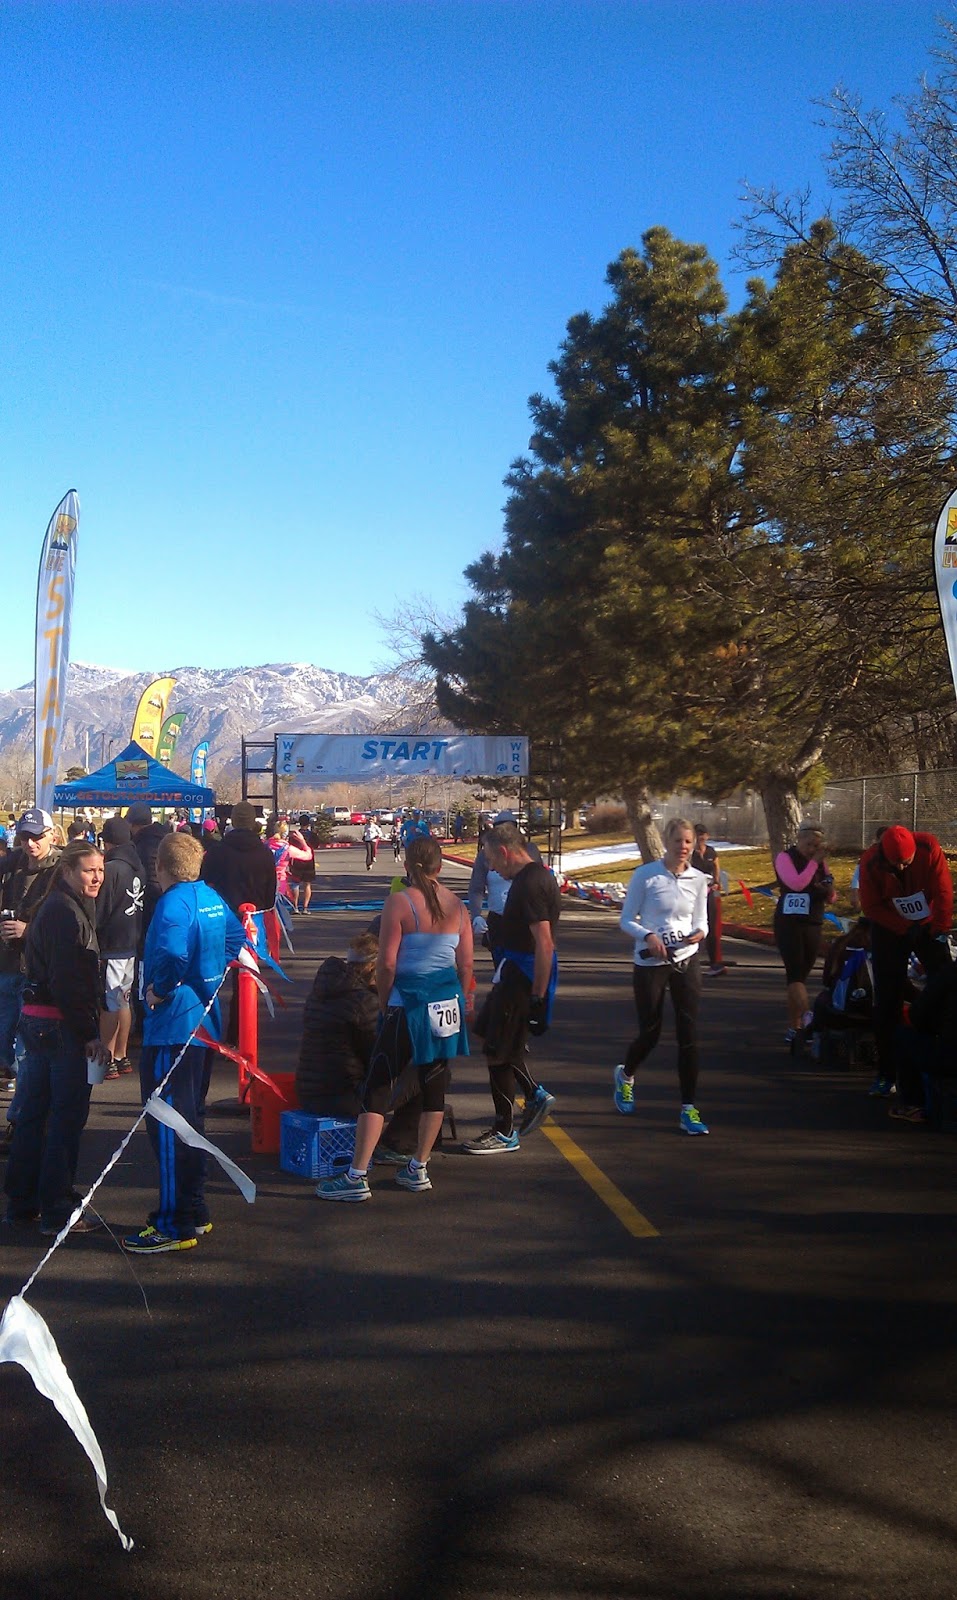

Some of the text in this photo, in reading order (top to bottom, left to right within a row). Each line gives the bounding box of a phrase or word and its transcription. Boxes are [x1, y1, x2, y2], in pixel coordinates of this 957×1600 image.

[41, 576, 65, 785] STAR
[361, 740, 447, 760] START
[789, 898, 805, 908] 602
[900, 900, 923, 914] 600
[662, 930, 684, 946] 669
[437, 1008, 458, 1027] 706
